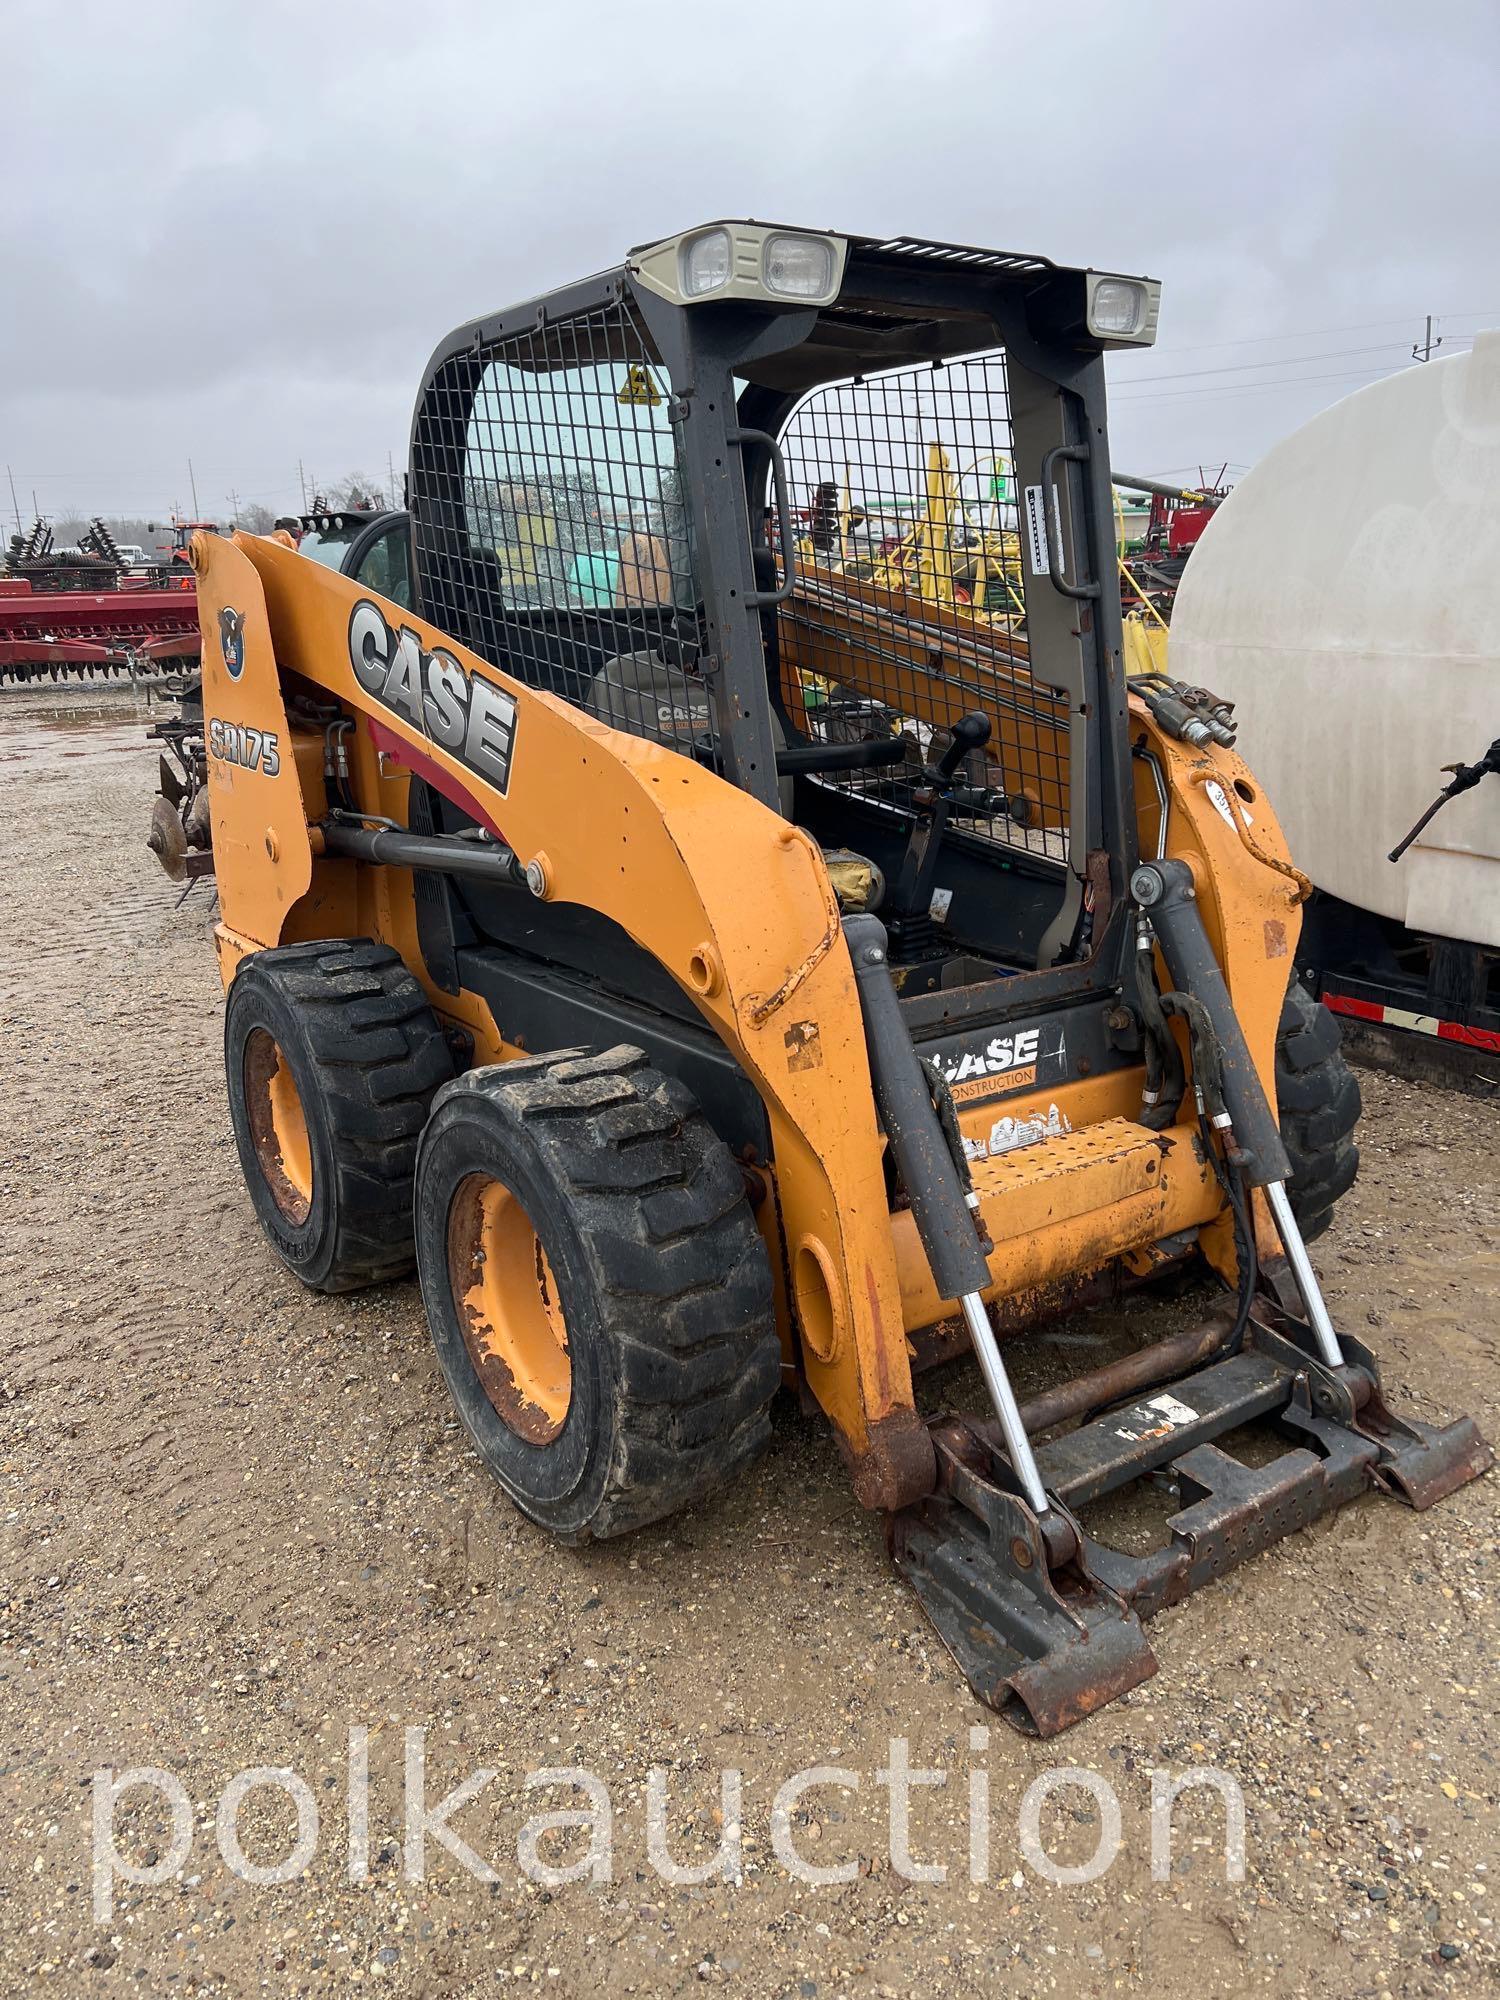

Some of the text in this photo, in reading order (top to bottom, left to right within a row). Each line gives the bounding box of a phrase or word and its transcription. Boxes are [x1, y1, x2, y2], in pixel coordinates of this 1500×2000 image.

[349, 600, 516, 788] CASE
[658, 705, 709, 721] CASE
[662, 720, 708, 731] COSTRUTION
[210, 718, 280, 777] SR175
[951, 1069, 1033, 1100] ONSTRUCTION
